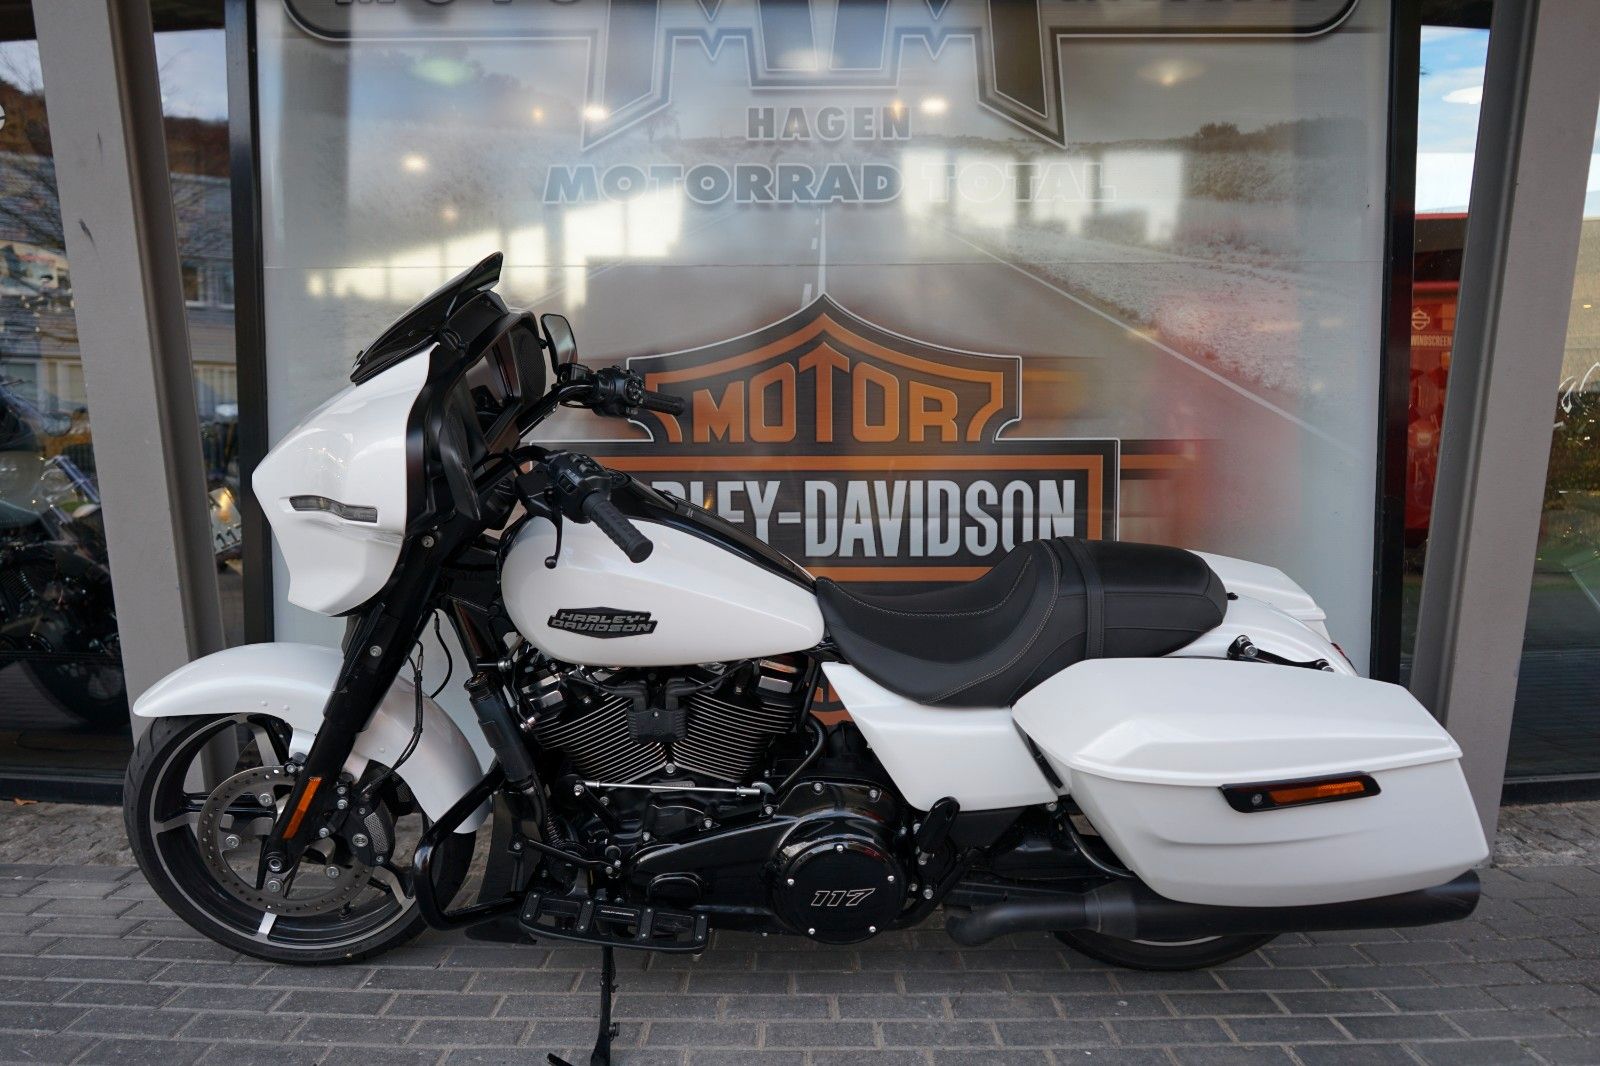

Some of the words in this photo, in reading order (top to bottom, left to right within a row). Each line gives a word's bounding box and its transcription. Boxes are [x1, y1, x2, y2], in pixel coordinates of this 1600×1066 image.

[747, 105, 912, 141] HAGEN
[543, 163, 904, 204] MOTORRAD
[920, 162, 1117, 203] TOTAL
[692, 341, 958, 443] MOTOR
[551, 619, 653, 632] DAVIDSON
[560, 612, 646, 624] HARLEY-
[810, 887, 877, 907] 117
